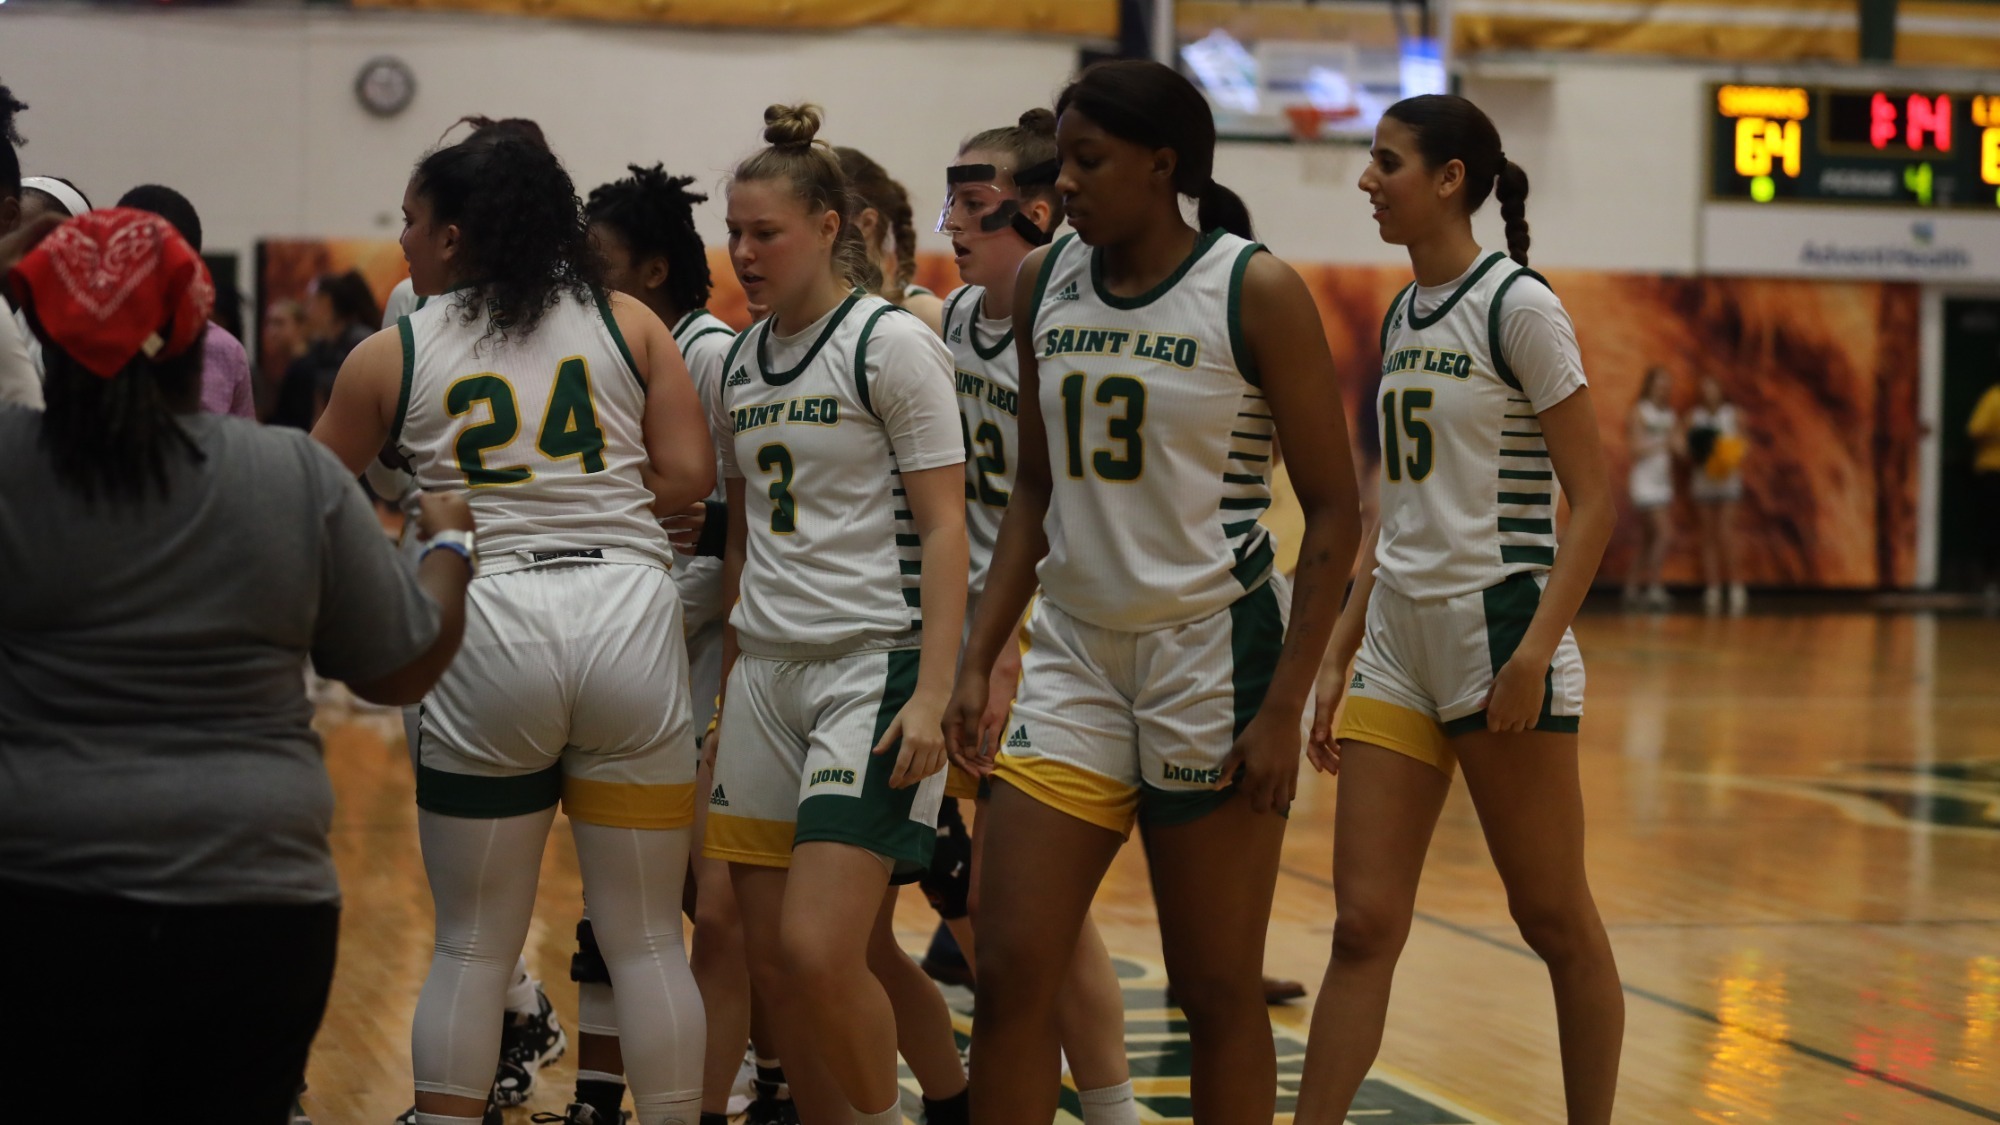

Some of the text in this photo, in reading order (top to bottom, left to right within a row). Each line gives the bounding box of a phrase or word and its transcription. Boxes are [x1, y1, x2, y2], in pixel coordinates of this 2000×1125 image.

[1735, 116, 1801, 178] 64
[1904, 162, 1933, 205] 4
[1044, 327, 1199, 369] SAINT LEO
[1424, 349, 1473, 380] LEO
[787, 397, 839, 426] LEO
[955, 370, 1018, 417] INT LEO
[444, 355, 609, 489] 24
[1060, 371, 1148, 483] 13
[1382, 388, 1435, 484] 15
[756, 441, 798, 535] 3
[1007, 738, 1031, 748] adidas
[809, 769, 856, 788] LIONS
[1163, 762, 1221, 784] LIONS
